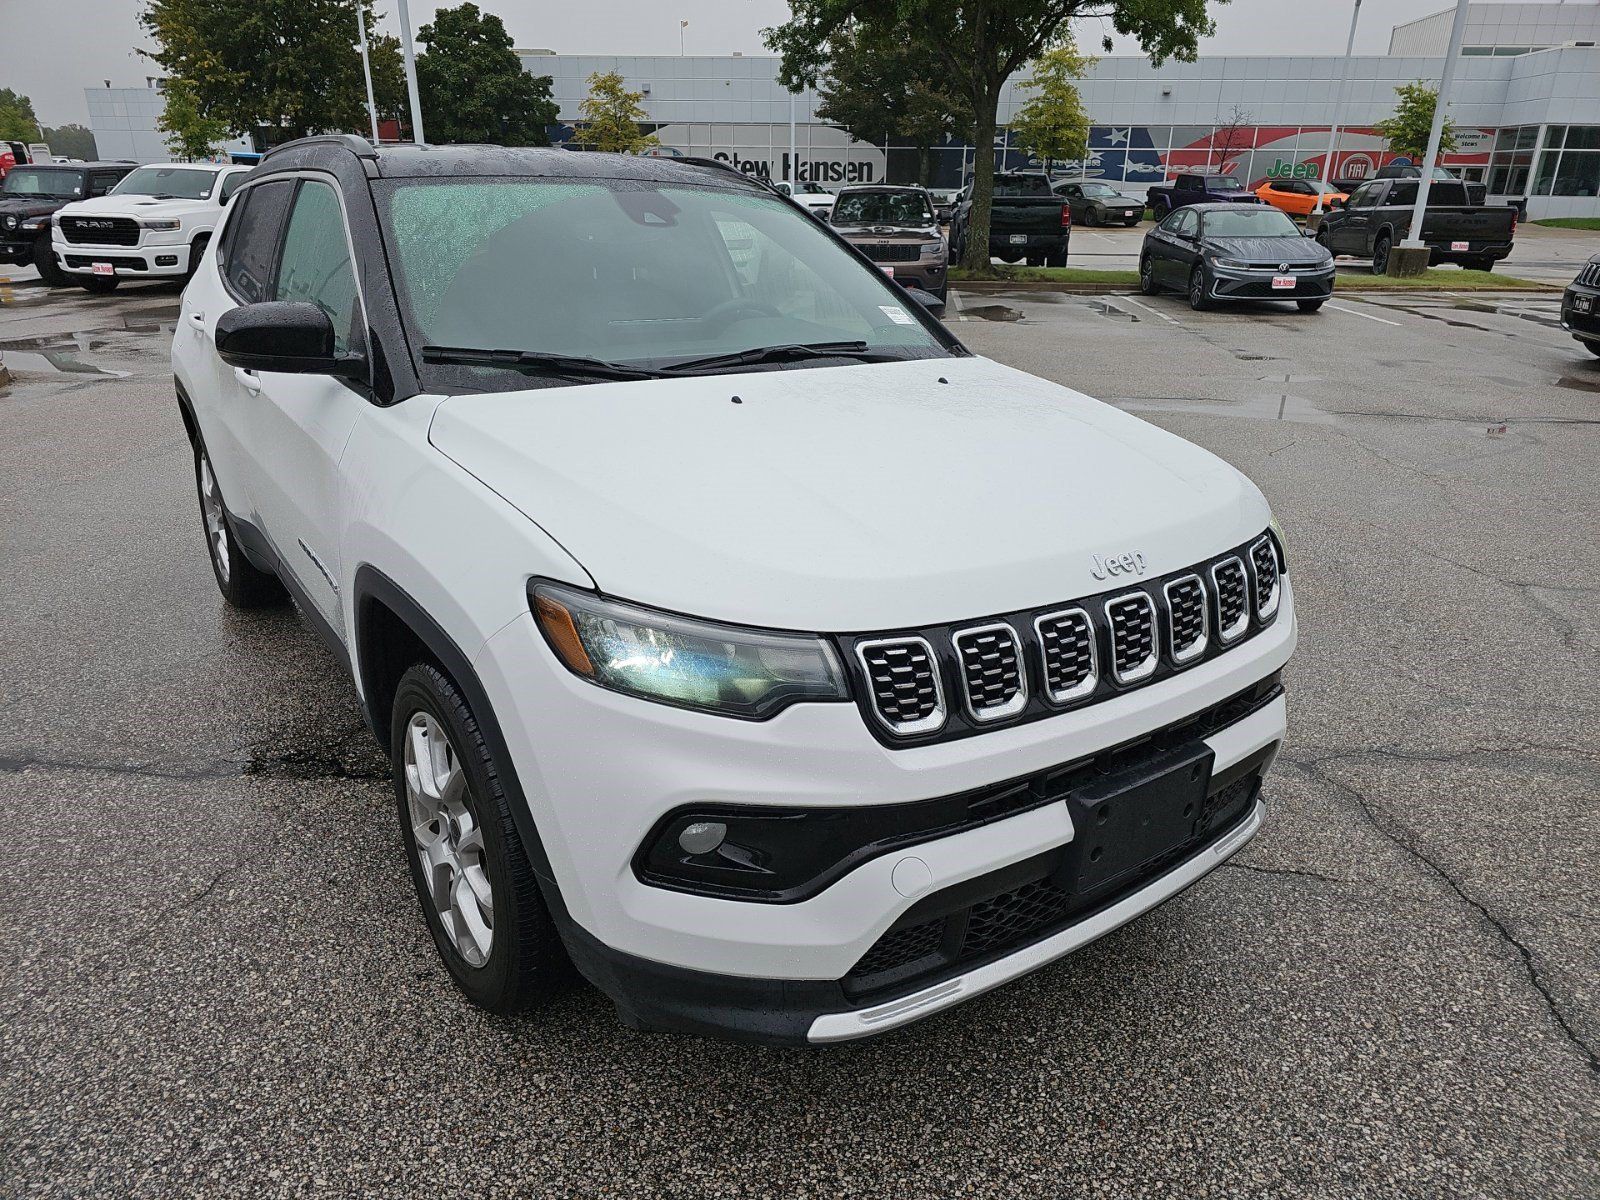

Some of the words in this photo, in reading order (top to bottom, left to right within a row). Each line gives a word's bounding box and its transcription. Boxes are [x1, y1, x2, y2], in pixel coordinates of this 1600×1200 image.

[782, 152, 874, 182] Hansen
[1266, 158, 1320, 180] Jeep
[1348, 163, 1367, 178] FIAT
[75, 220, 114, 229] RAM
[1089, 549, 1147, 581] Jeep
